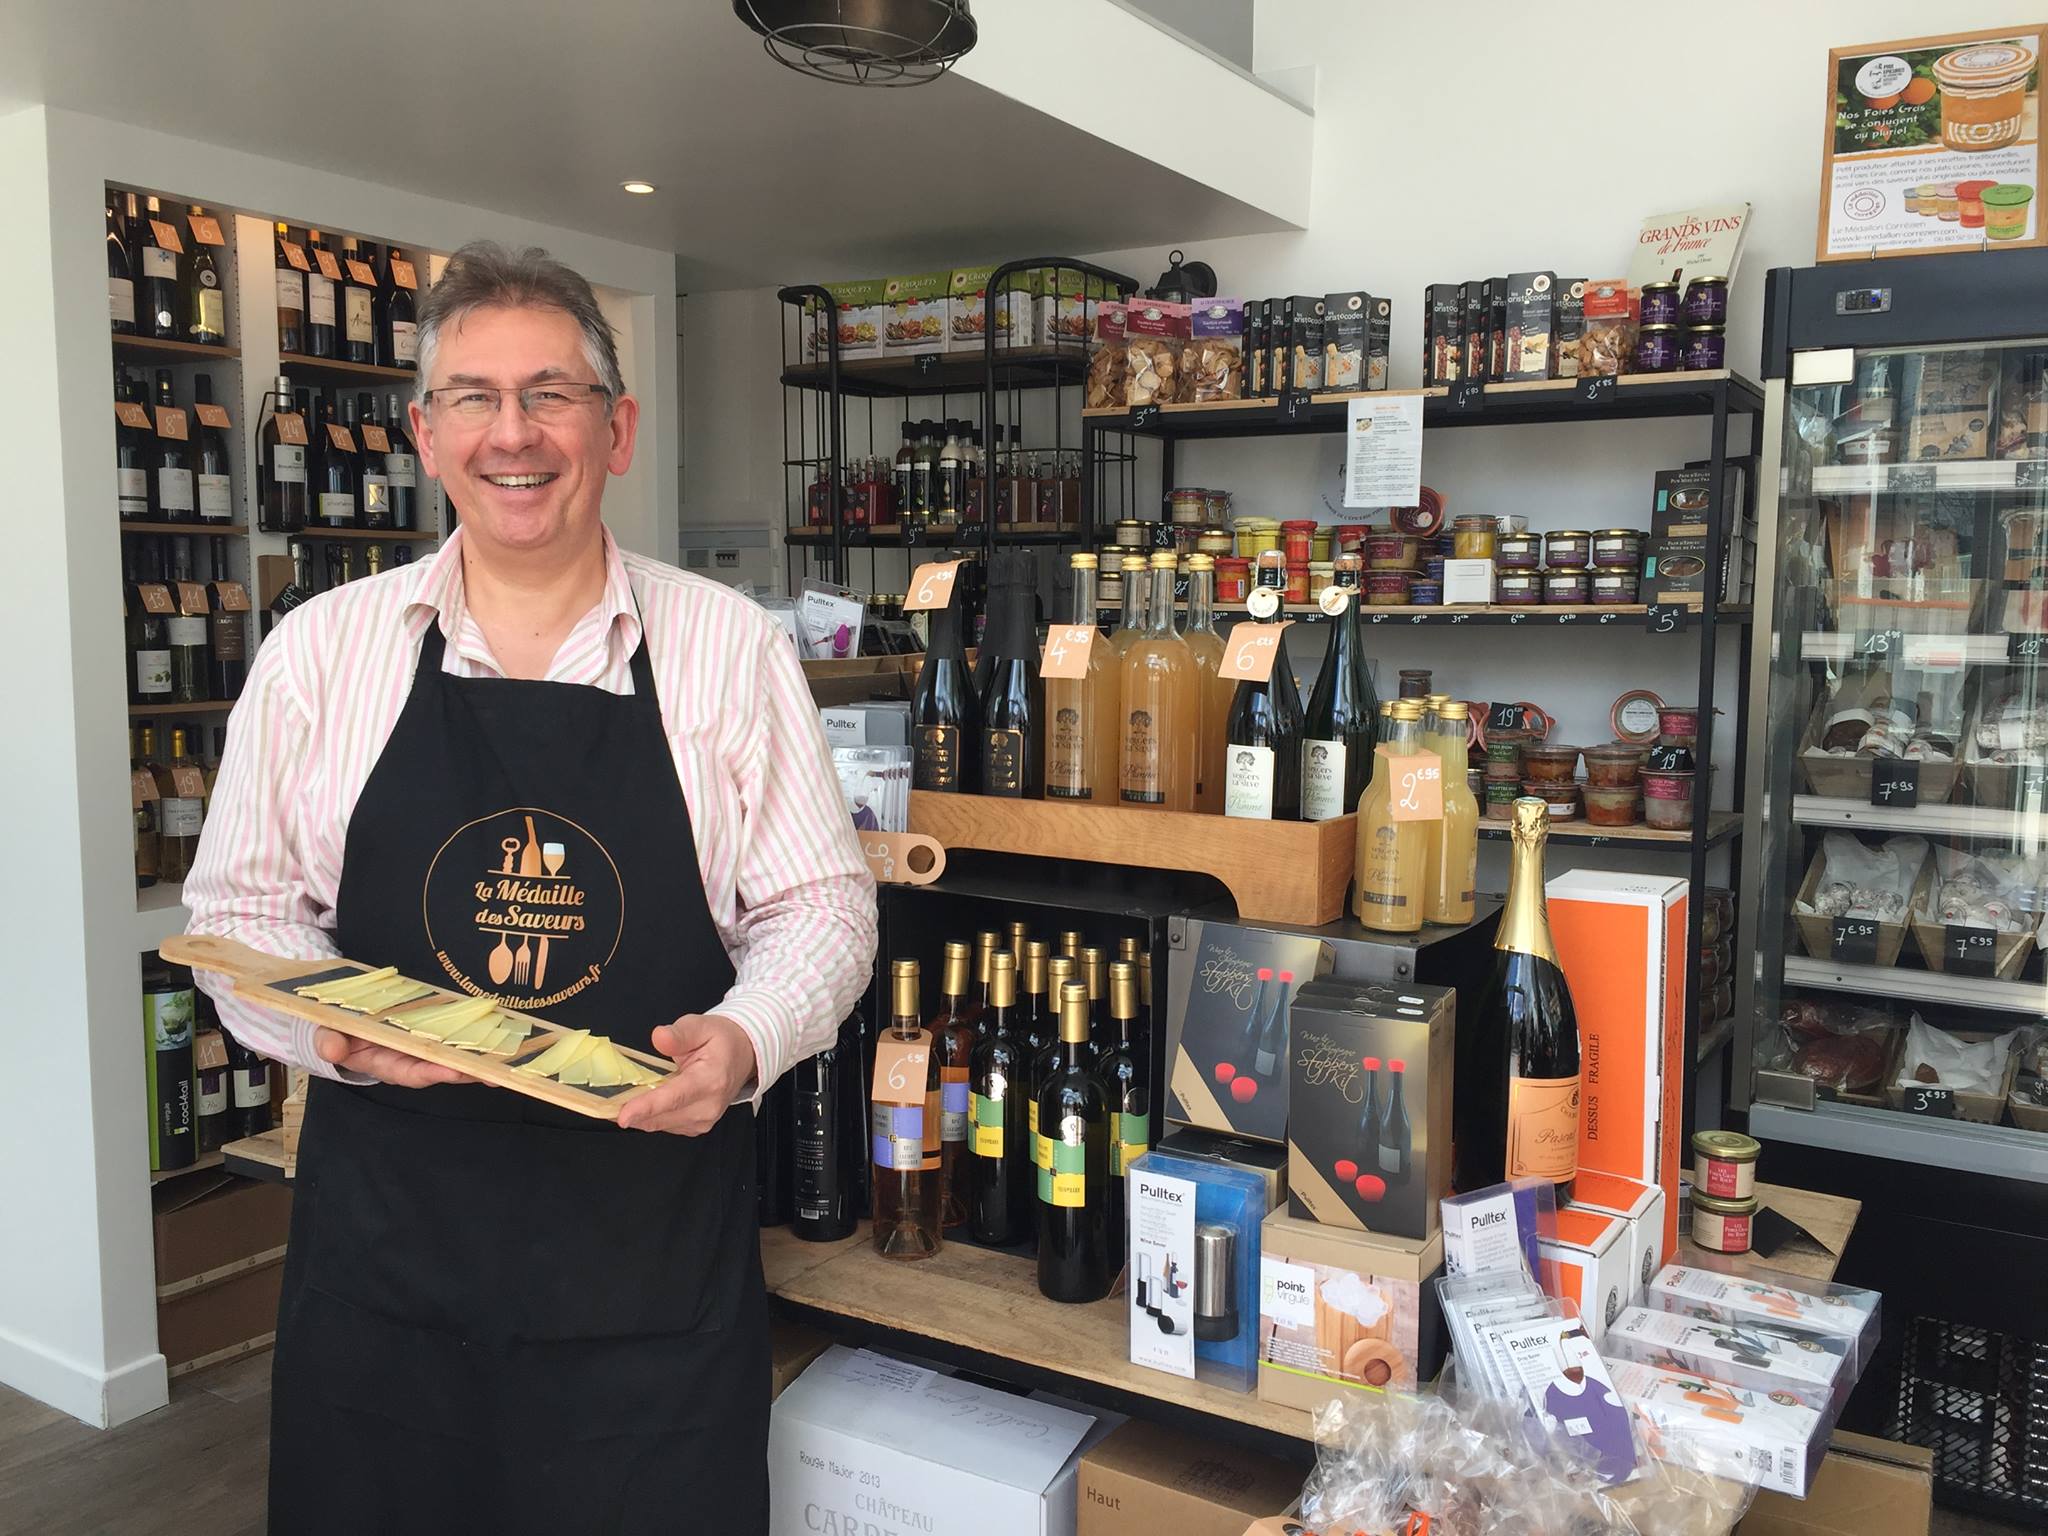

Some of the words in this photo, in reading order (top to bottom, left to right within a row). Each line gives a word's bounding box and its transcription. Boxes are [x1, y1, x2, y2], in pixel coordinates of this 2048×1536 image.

[1838, 111, 1859, 119] Nos
[1864, 108, 1894, 117] Foies
[1898, 104, 1926, 113] Gras
[1861, 114, 1918, 128] conjugent
[1854, 132, 1868, 140] au
[1872, 126, 1907, 140] pluriel
[1640, 222, 1703, 244] GRANDS
[1705, 215, 1742, 234] VINS
[1656, 239, 1672, 255] de
[1508, 291, 1551, 304] aristocodes
[918, 570, 953, 604] 6€95
[807, 595, 835, 608] Pulltex
[1050, 629, 1090, 667] 4€95
[826, 718, 857, 730] Pulltex
[1399, 767, 1440, 810] 2€95
[1878, 780, 1914, 800] 7€95
[474, 881, 493, 902] La
[496, 879, 585, 906] Médaille
[475, 909, 503, 926] des
[503, 905, 585, 931] Saveurs
[1835, 926, 1874, 946] 7€95
[1955, 936, 1993, 958] 7€95
[1200, 960, 1255, 994] Stoppers
[1296, 1048, 1360, 1086] Stoppers
[1588, 1032, 1600, 1084] FRAGILE
[1329, 1068, 1364, 1104] Kit
[178, 1079, 189, 1125] cocktail
[1913, 1090, 1947, 1111] 3€95
[1587, 1095, 1599, 1141] DESSUS
[1140, 1183, 1182, 1203] Pulltex
[1471, 1210, 1506, 1229] Pulltex
[1277, 1280, 1306, 1293] point
[1666, 1270, 1687, 1287] Pulltex
[1277, 1291, 1311, 1306] virgule
[1626, 1312, 1648, 1332] Pulltex
[1510, 1335, 1549, 1351] Pulltex
[800, 1450, 825, 1470] Rouge
[828, 1460, 854, 1480] Major
[859, 1470, 881, 1488] 2013
[1086, 1485, 1121, 1511] Haut
[855, 1493, 934, 1533] CHÂTEAU
